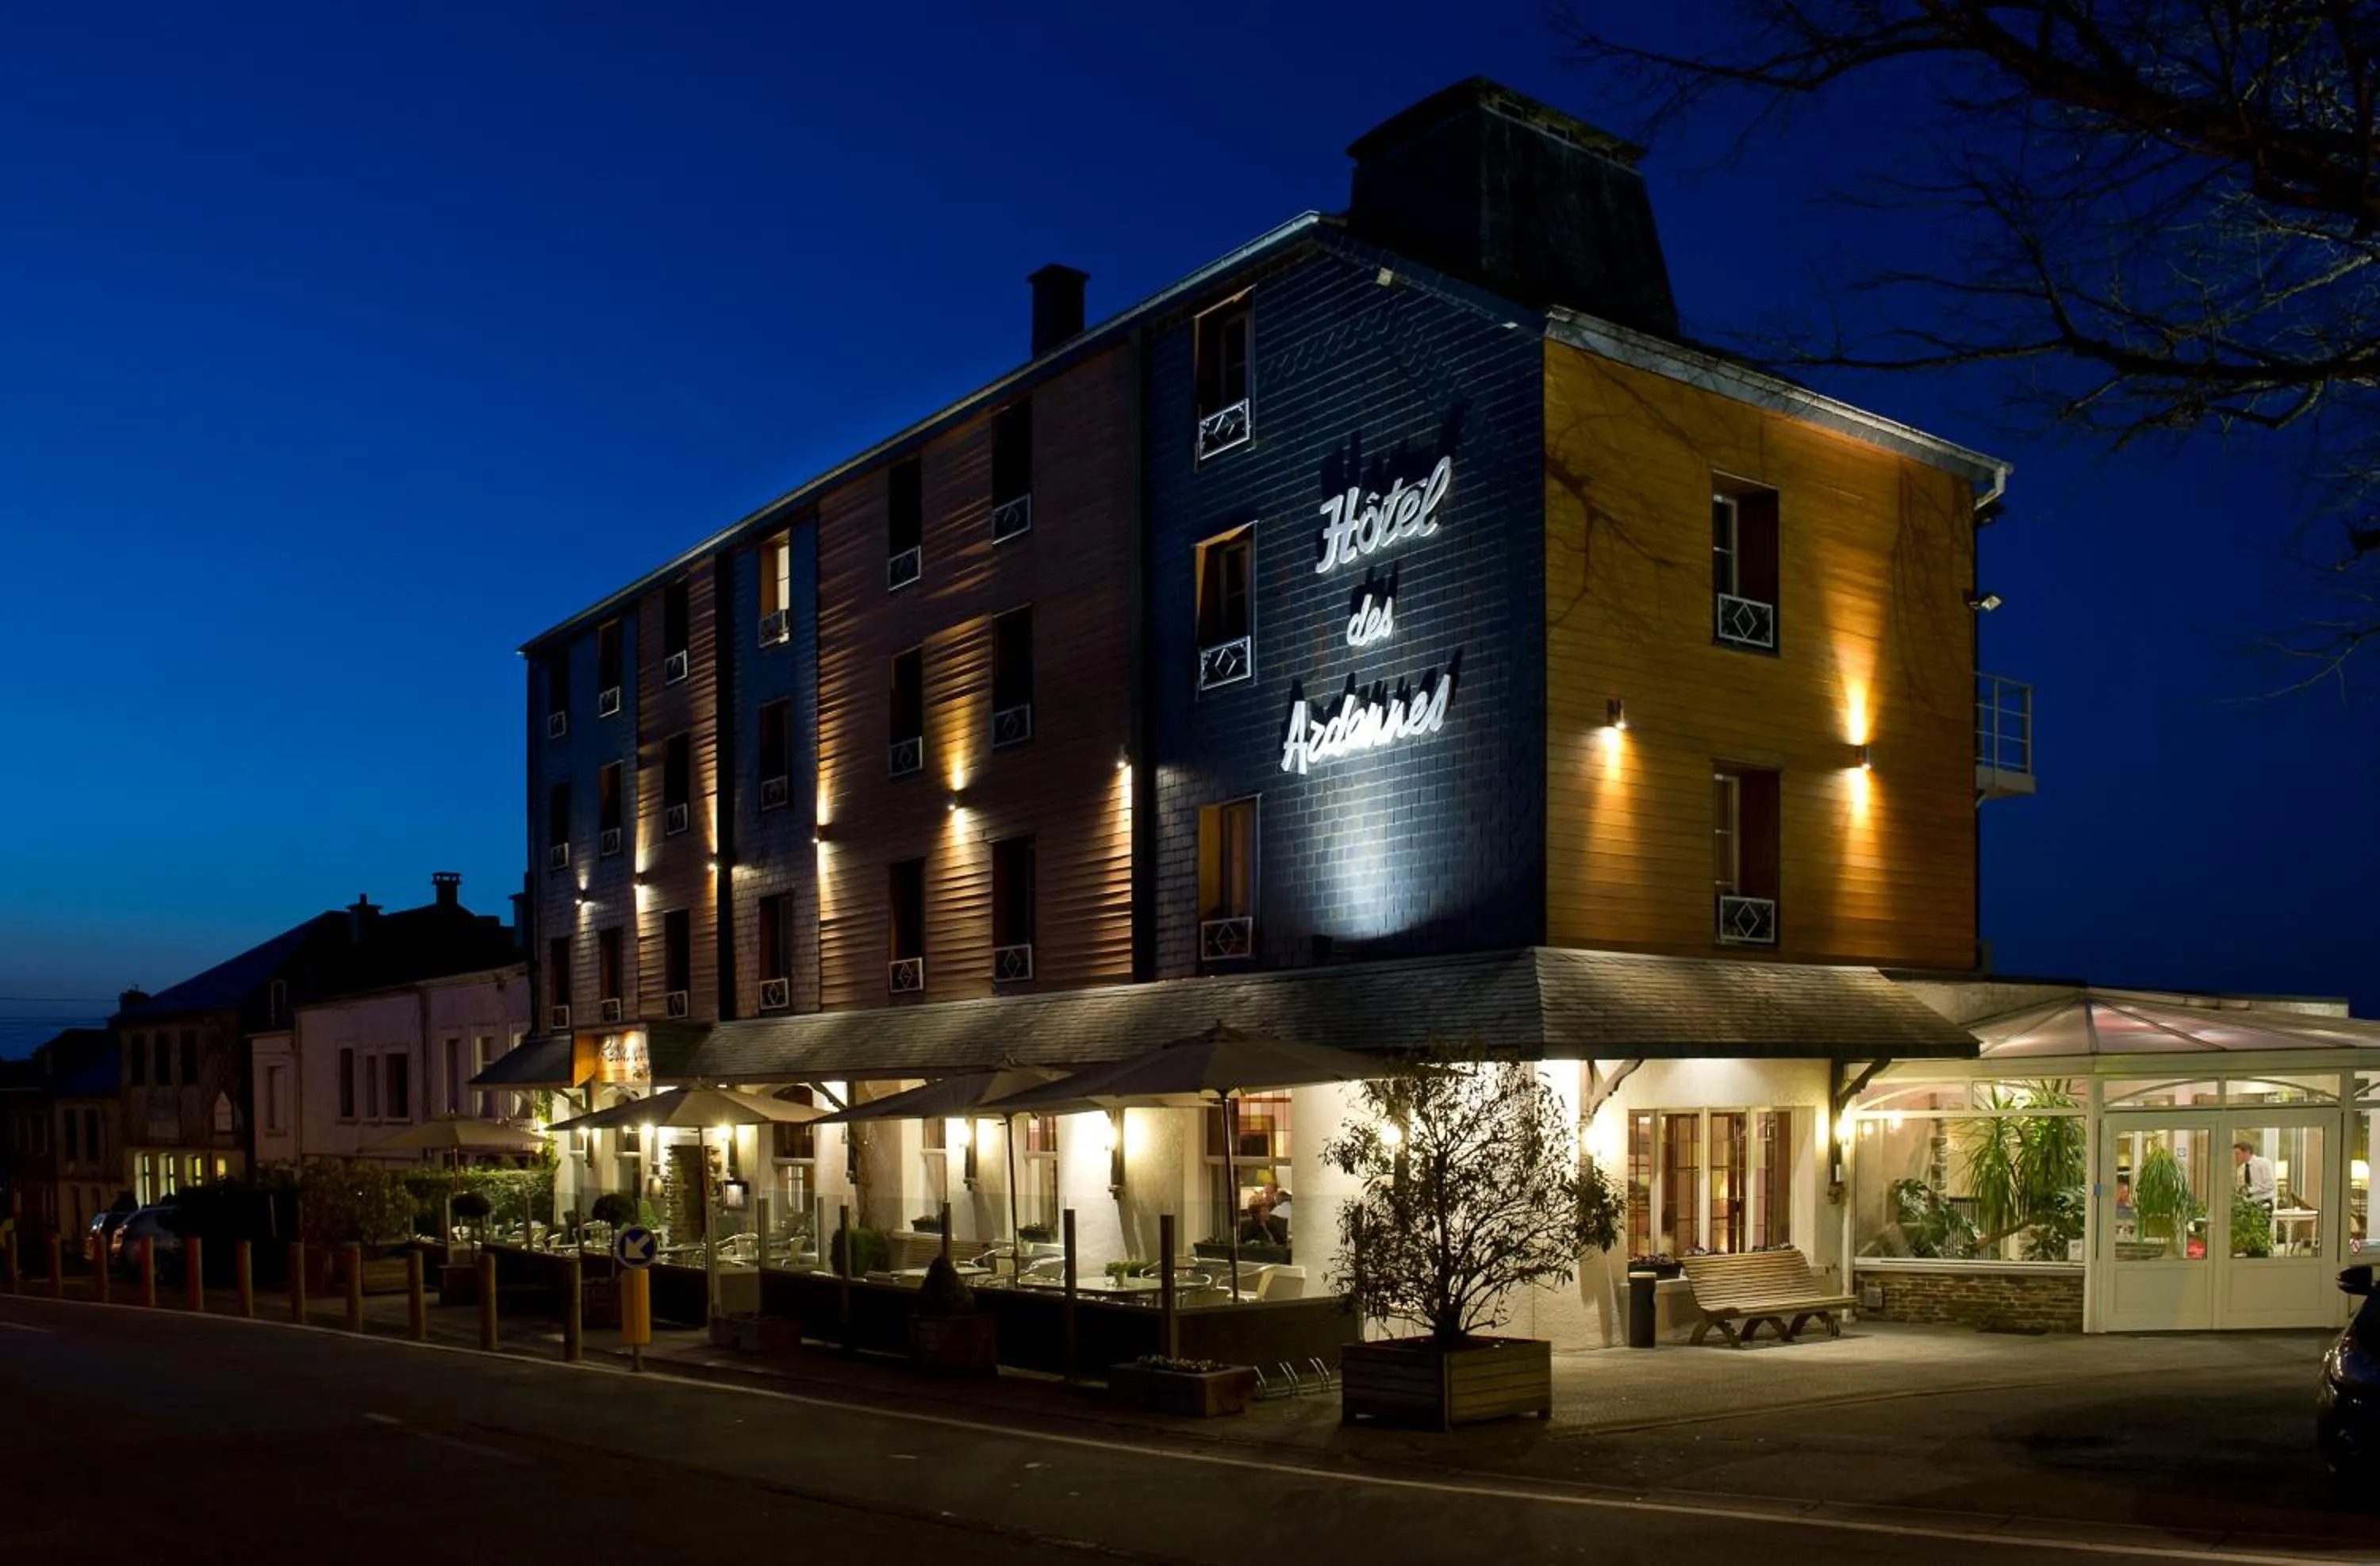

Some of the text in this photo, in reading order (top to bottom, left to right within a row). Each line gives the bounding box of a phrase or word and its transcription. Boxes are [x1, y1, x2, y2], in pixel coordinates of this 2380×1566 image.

[1315, 455, 1453, 573] Hôtel
[1347, 593, 1394, 647] des
[1280, 674, 1450, 775] Ardennes
